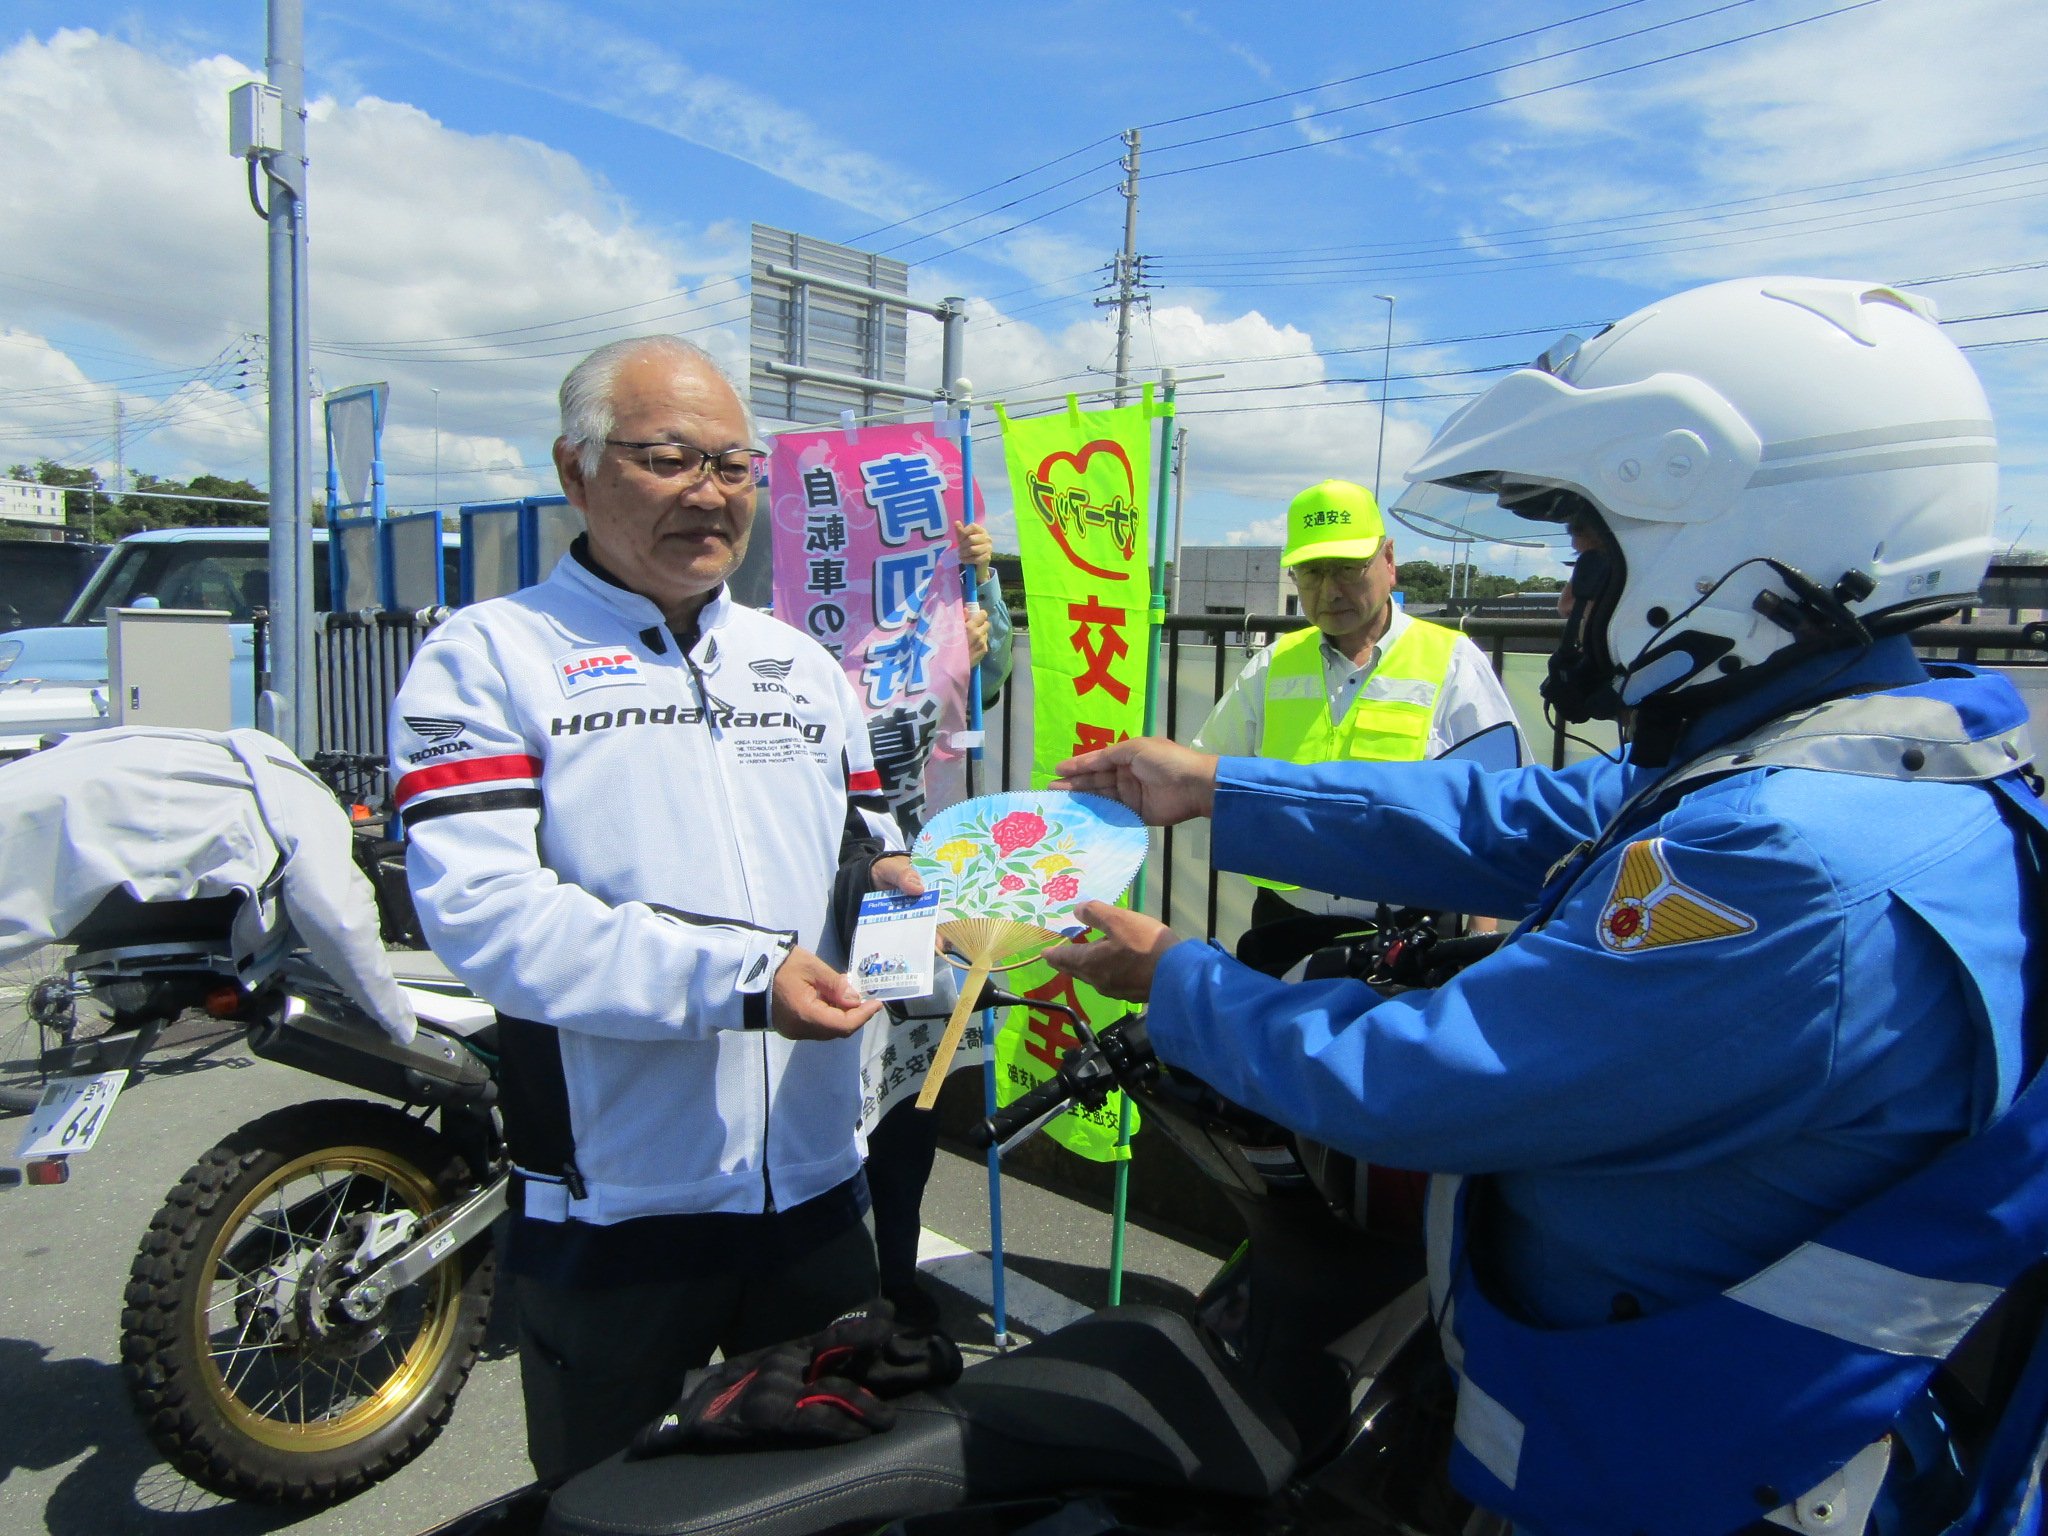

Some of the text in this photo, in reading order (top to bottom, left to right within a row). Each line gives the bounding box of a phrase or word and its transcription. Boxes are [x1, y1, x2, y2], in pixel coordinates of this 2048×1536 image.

[1303, 510, 1352, 529] 交通安全
[563, 654, 637, 686] HRC
[408, 741, 474, 764] HONDA
